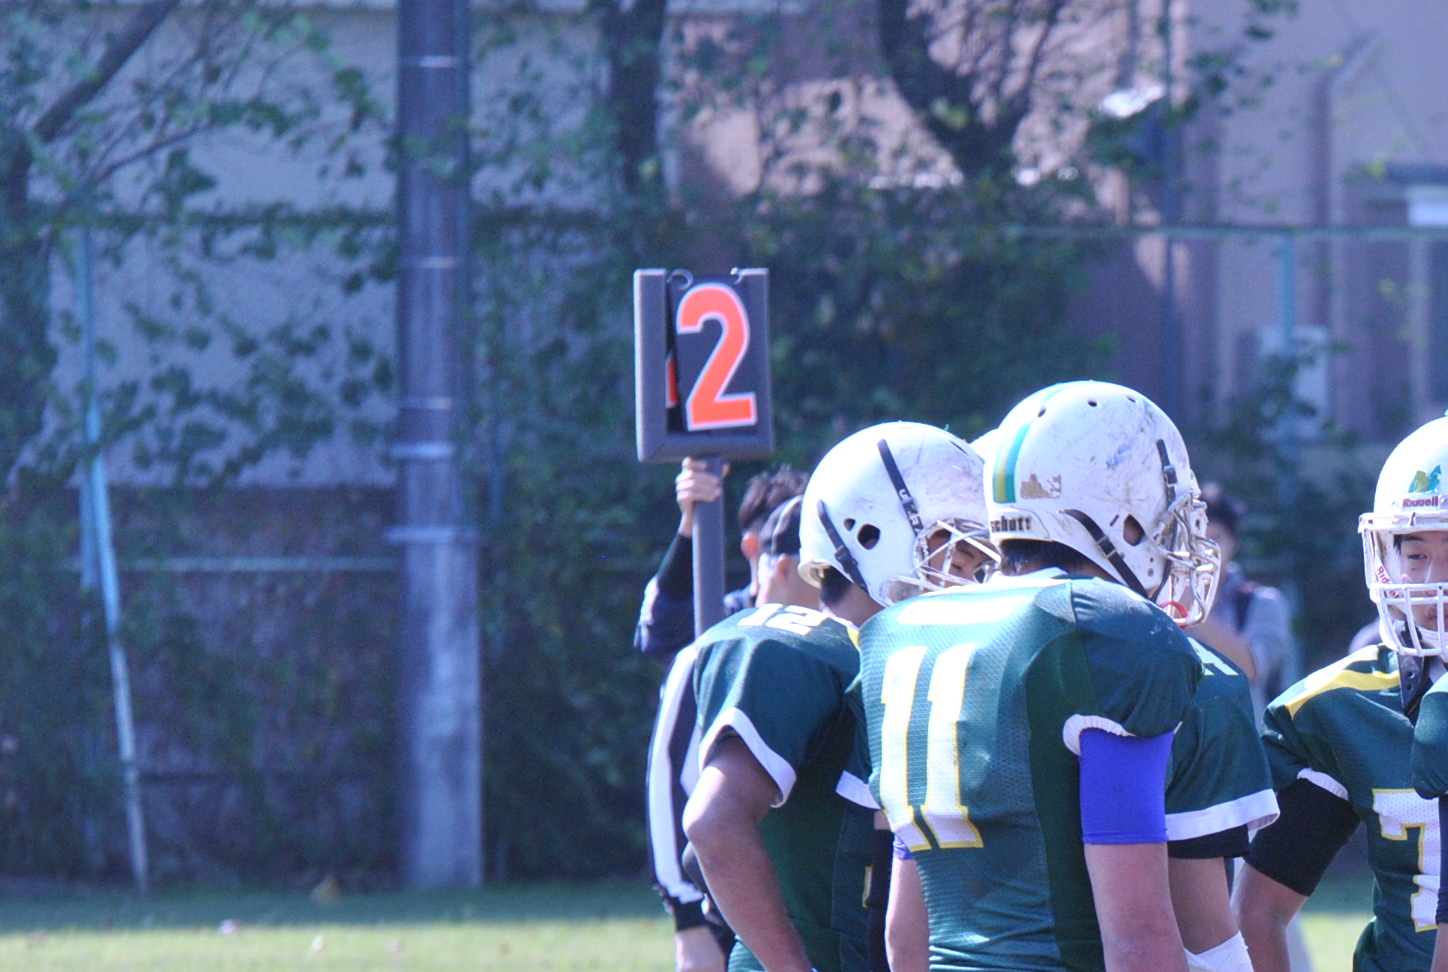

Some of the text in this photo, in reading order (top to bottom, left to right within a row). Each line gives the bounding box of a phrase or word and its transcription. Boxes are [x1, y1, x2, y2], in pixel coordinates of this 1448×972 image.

[676, 281, 758, 432] 2
[737, 602, 829, 636] 12
[879, 641, 984, 852] 11
[1371, 788, 1442, 933] 7
